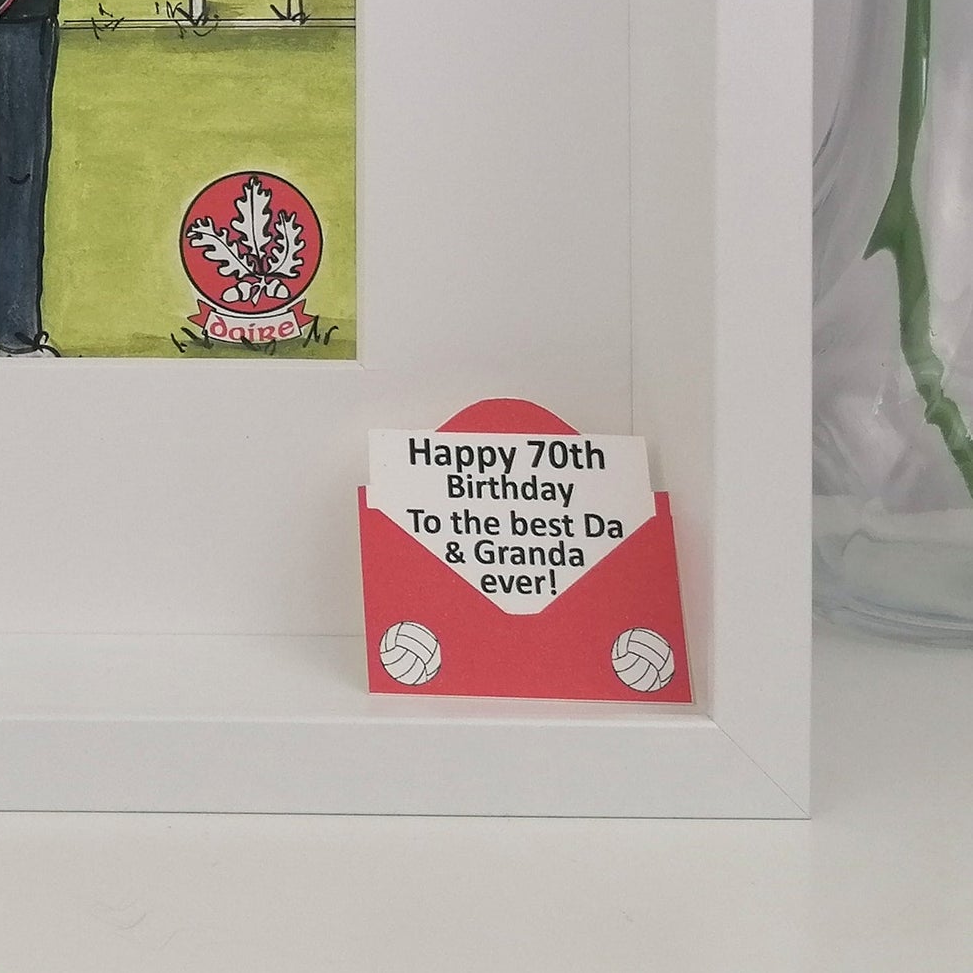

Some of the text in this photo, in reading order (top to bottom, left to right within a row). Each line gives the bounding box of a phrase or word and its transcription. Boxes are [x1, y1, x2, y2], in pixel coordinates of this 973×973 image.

[408, 438, 606, 474] Happy 70th
[447, 474, 574, 508] Birthday
[406, 509, 624, 539] To the best Da
[445, 539, 586, 568] & Granda
[480, 568, 558, 596] ever!
